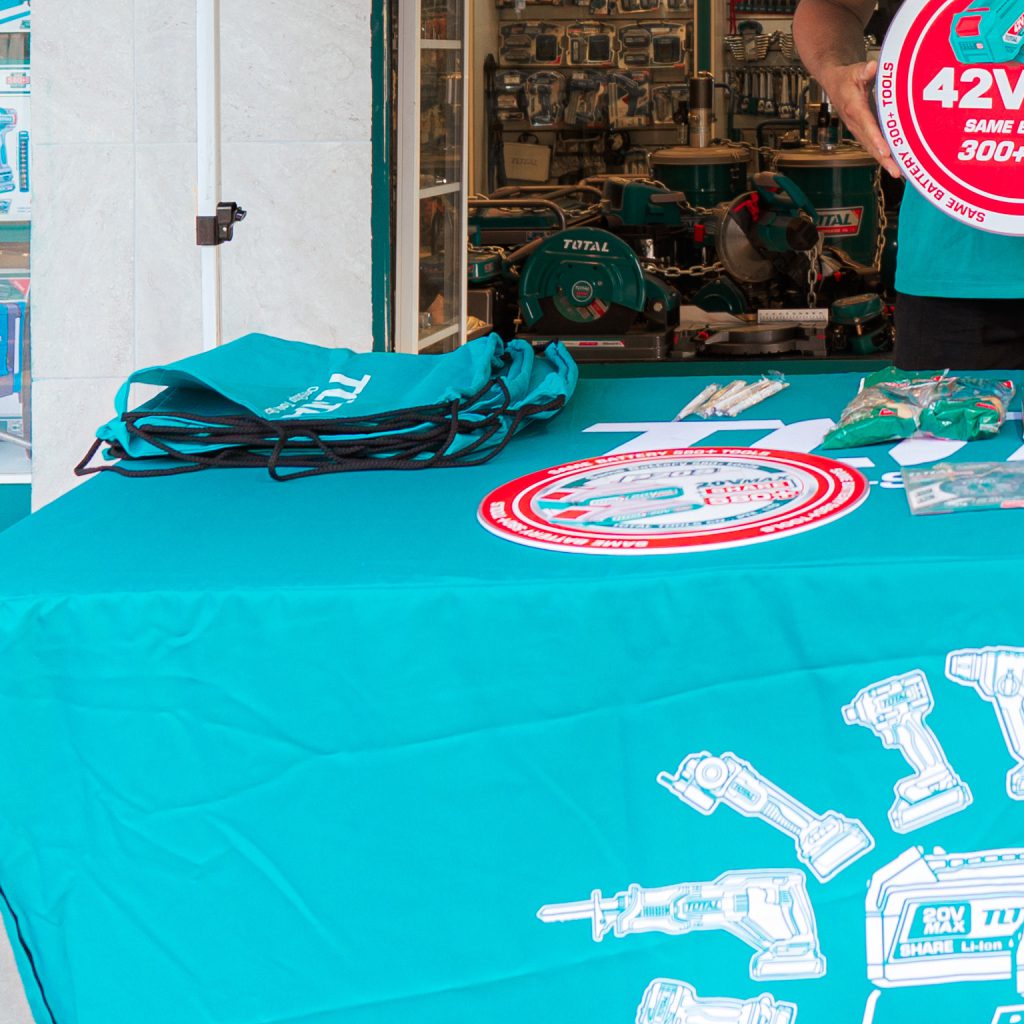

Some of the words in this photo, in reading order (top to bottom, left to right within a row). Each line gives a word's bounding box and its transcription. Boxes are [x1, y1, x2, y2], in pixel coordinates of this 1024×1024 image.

[882, 62, 895, 108] TOOLS
[888, 111, 904, 148] 300+
[964, 119, 1013, 135] SAME
[898, 150, 945, 202] BATTERY
[945, 198, 986, 224] SAME
[562, 239, 610, 252] TOTAL
[547, 461, 593, 475] SAME
[595, 450, 668, 464] BATTERY
[721, 449, 771, 457] TOOLS
[591, 539, 649, 549] SAME
[922, 906, 966, 923] 20V
[923, 921, 966, 935] MAX
[900, 939, 954, 957] SHARE
